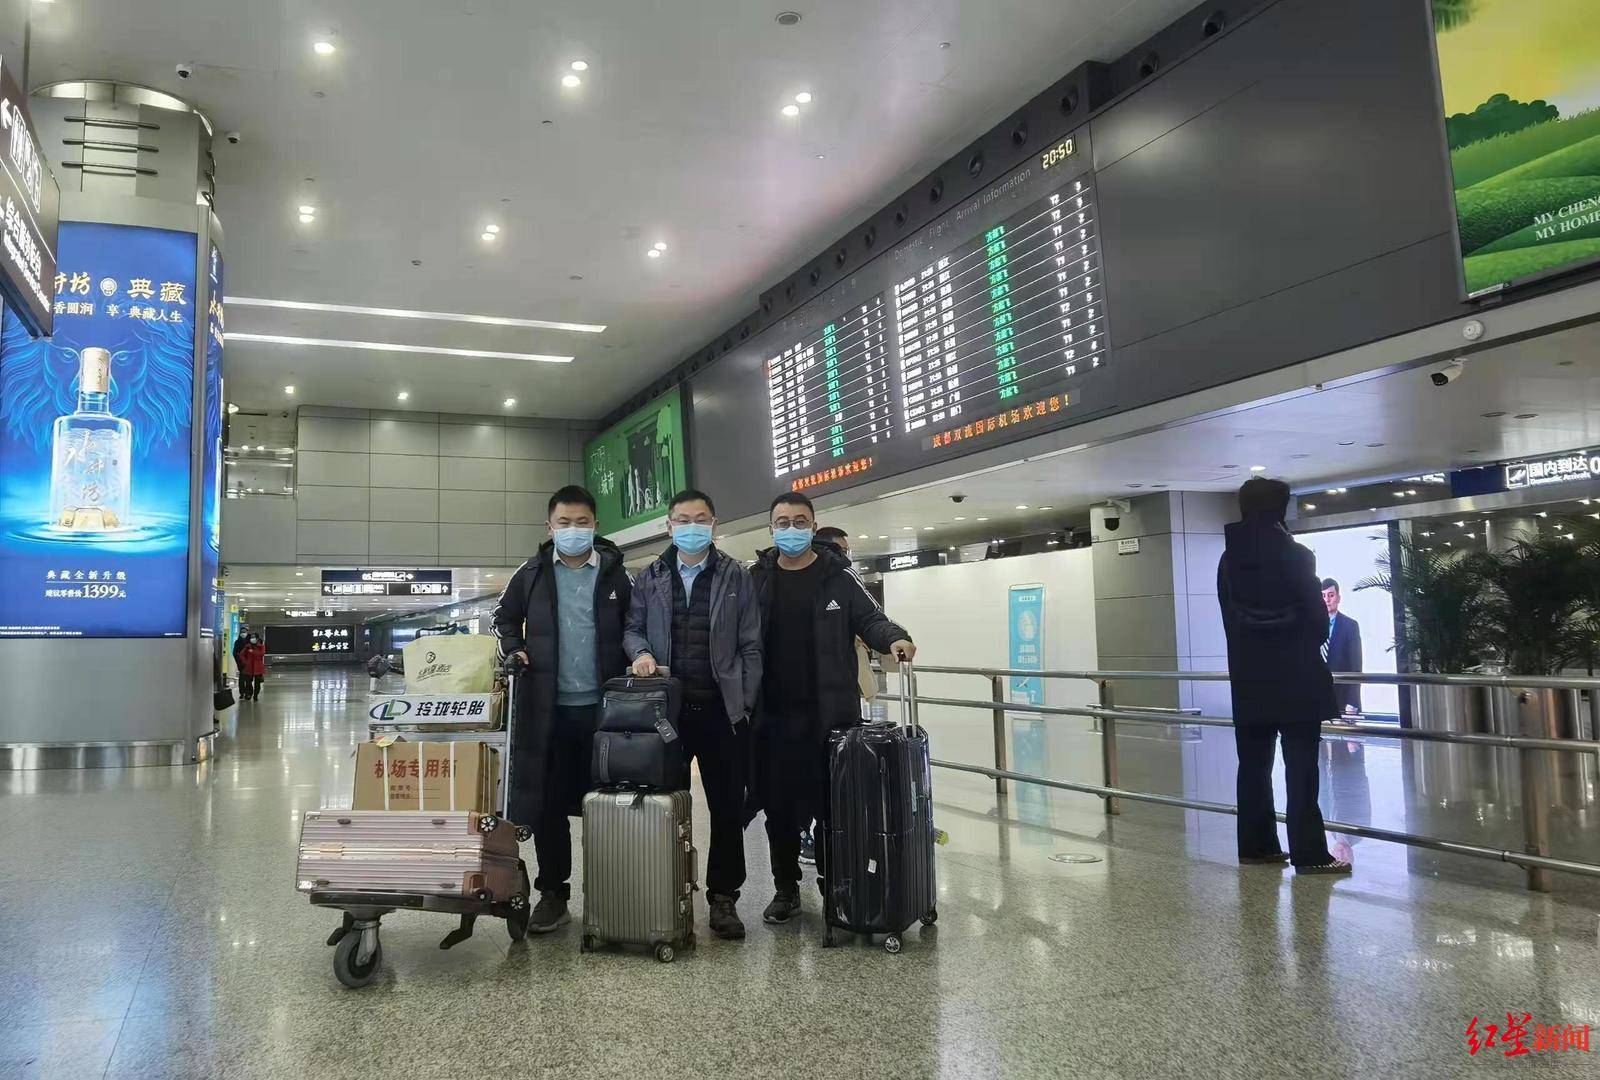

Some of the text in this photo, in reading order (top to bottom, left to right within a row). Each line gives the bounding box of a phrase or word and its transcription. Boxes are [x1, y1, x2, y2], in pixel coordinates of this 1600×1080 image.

[1042, 138, 1073, 169] 20:50
[983, 167, 1031, 204] Information
[1533, 195, 1600, 227] MY CHEN
[1535, 211, 1600, 241] MY HOME
[127, 278, 186, 305] 典藏
[1529, 456, 1588, 477] 国内到达
[46, 570, 126, 581] 典藏全新升级
[415, 700, 485, 716] 玲珑轮胎
